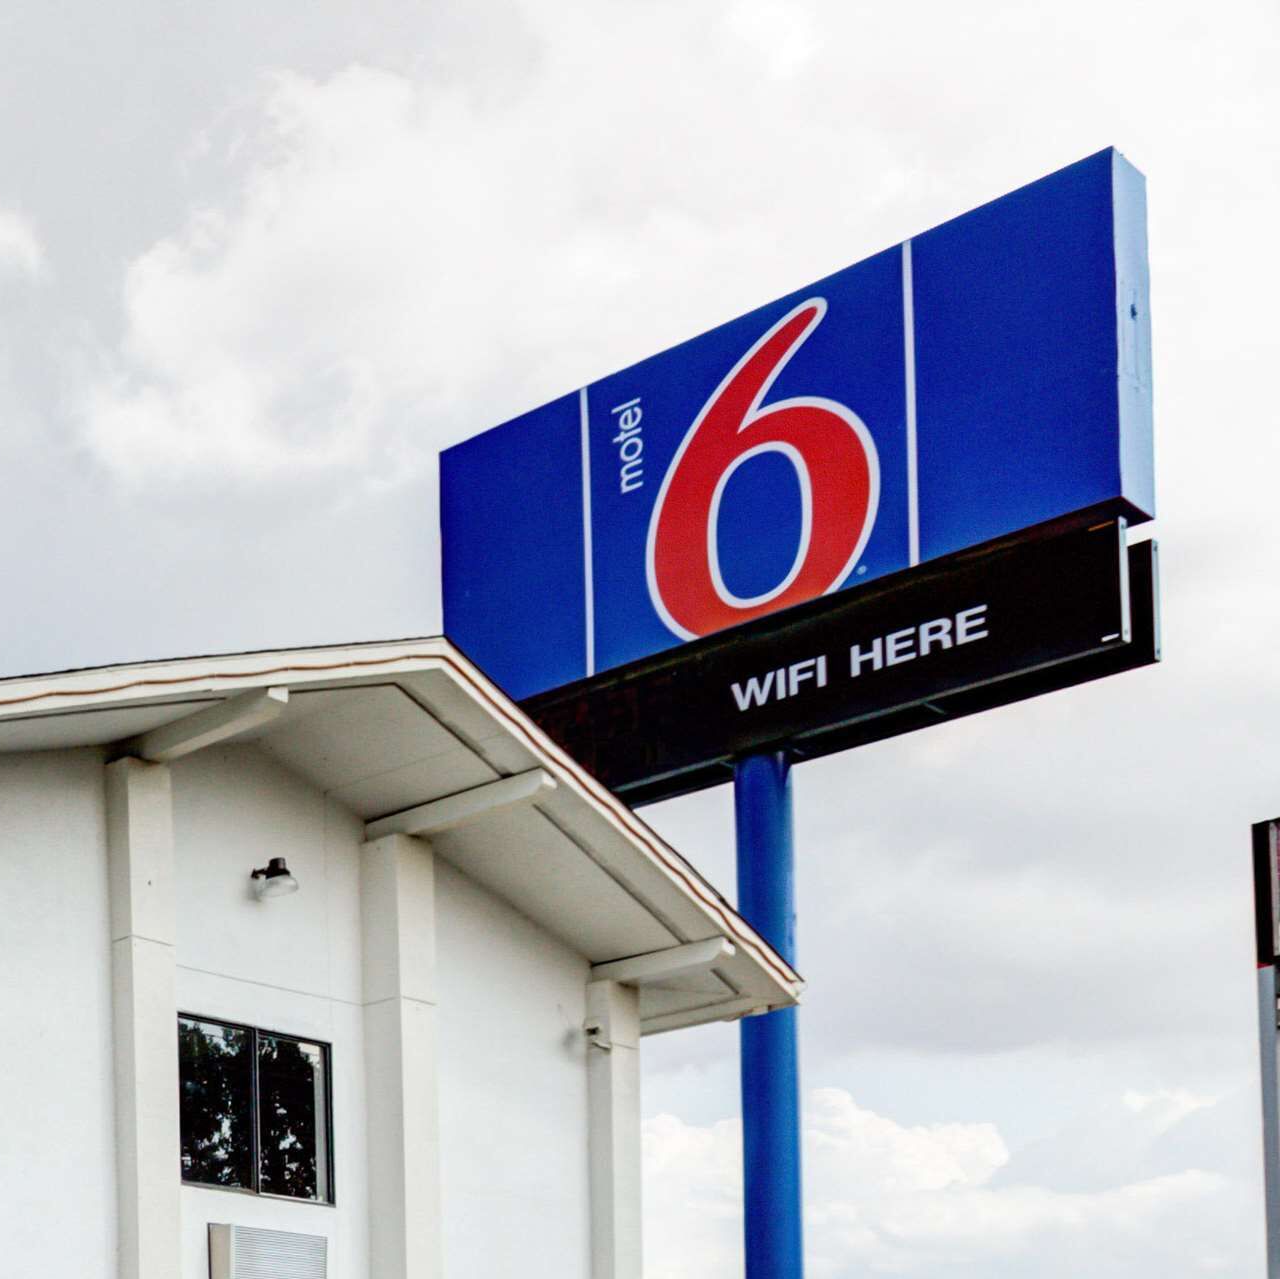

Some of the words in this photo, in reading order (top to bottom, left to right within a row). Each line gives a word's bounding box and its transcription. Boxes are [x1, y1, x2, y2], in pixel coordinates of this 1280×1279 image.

[613, 397, 643, 494] motel
[645, 296, 881, 642] 6
[730, 655, 827, 712] WIFI
[850, 604, 989, 677] HERE
